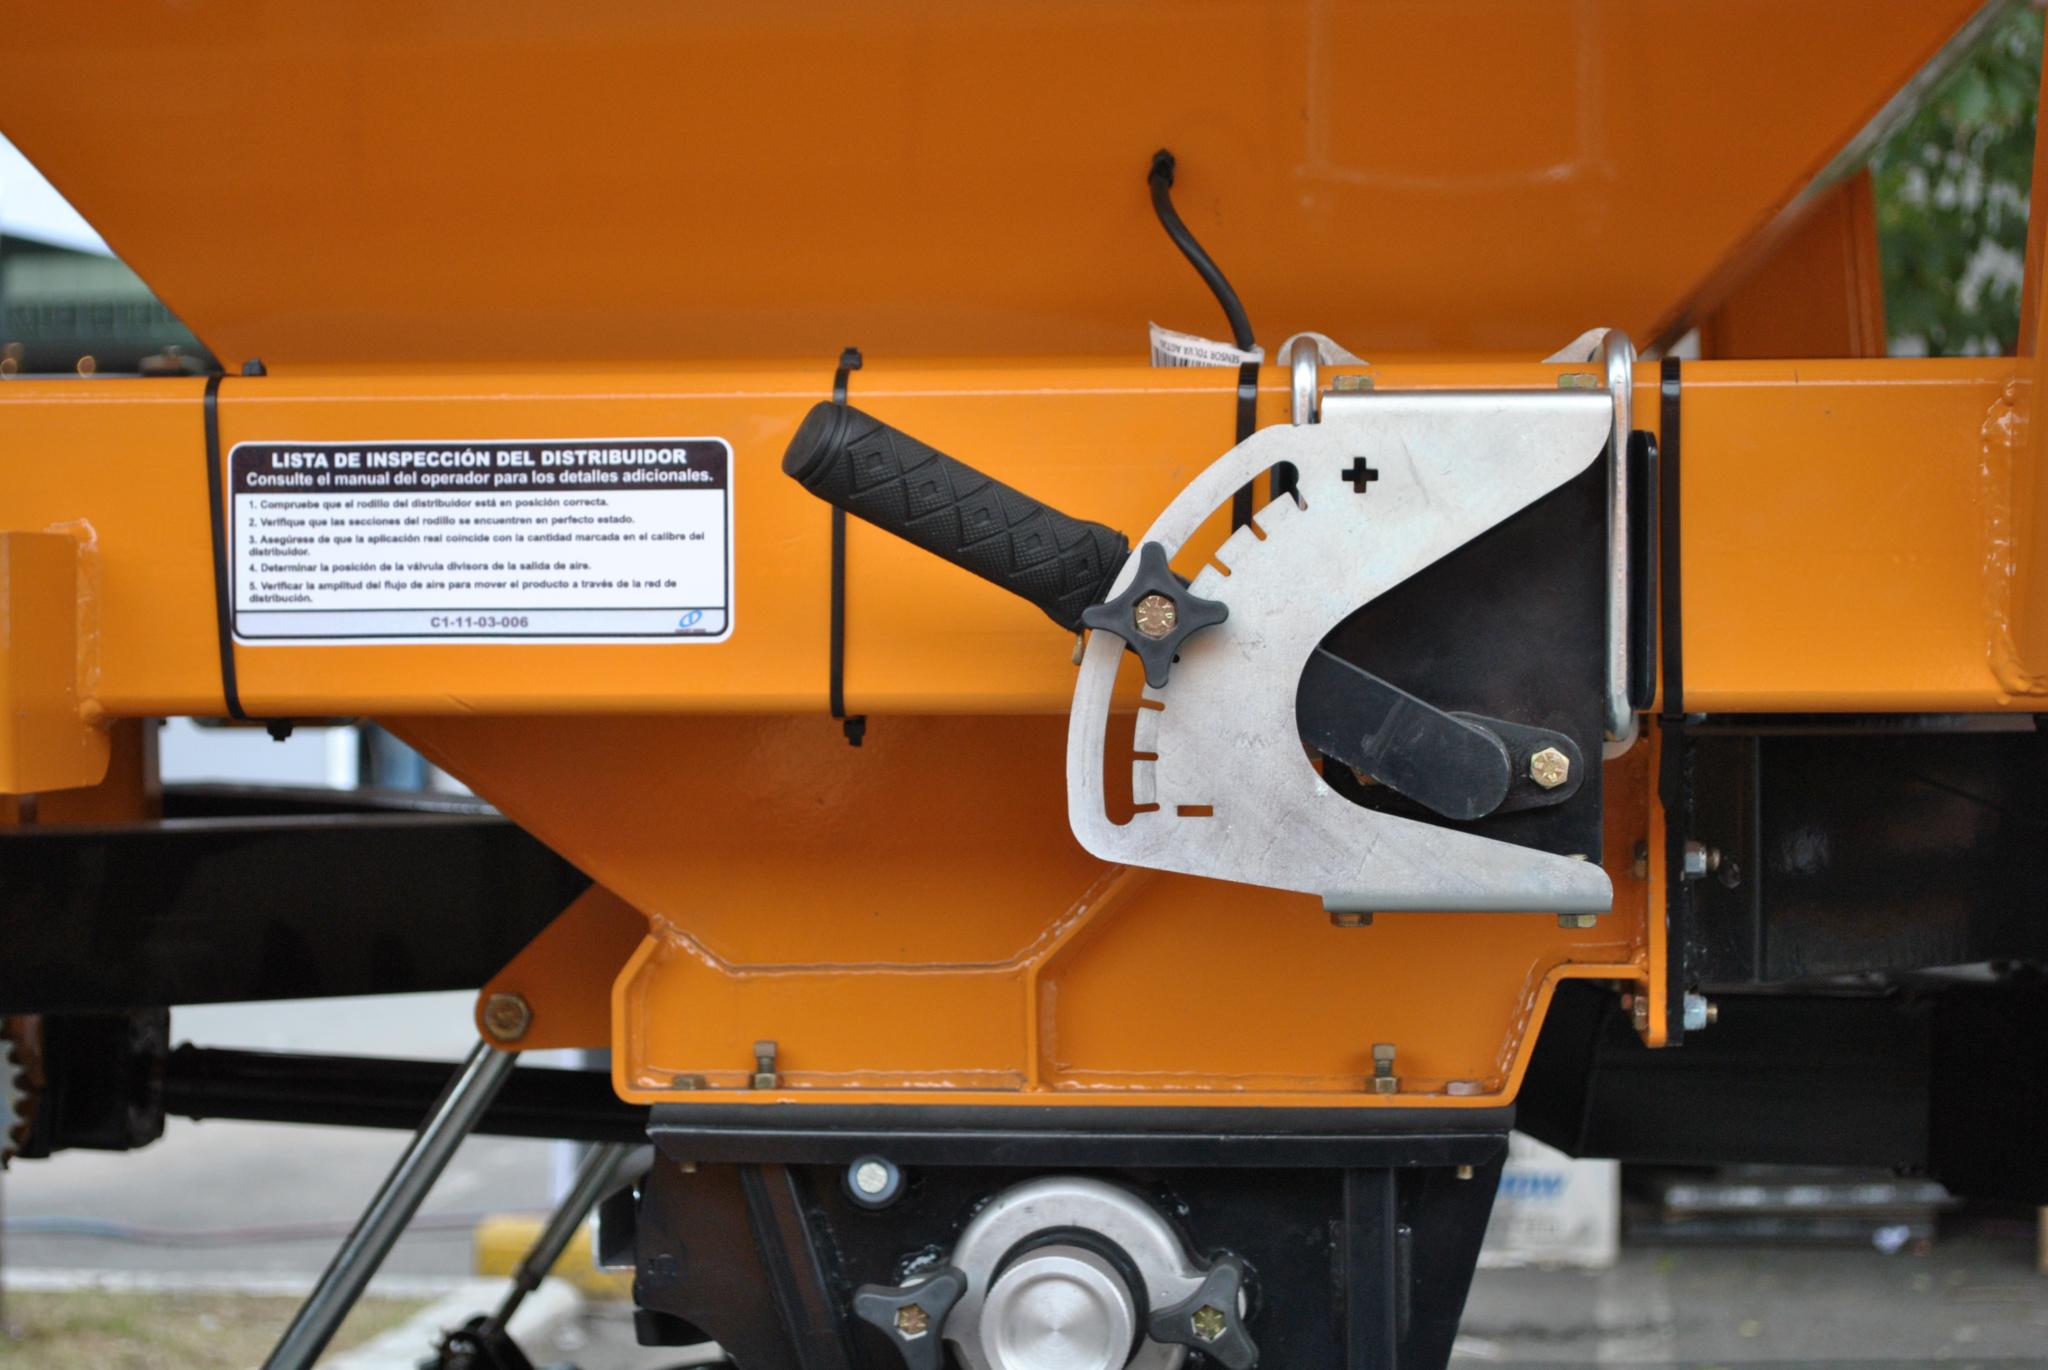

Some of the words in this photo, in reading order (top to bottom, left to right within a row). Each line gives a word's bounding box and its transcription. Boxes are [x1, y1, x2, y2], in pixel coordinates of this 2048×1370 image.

[1210, 350, 1241, 364] SENSOR
[271, 453, 329, 468] LISTA
[333, 453, 362, 467] DE
[366, 449, 491, 467] INSPECCIÓN
[496, 451, 536, 466] DEL
[540, 449, 688, 465] DISTRIBUIDOR
[246, 472, 314, 486] Consulte
[316, 473, 331, 485] el
[334, 472, 391, 485] manual
[393, 472, 418, 484] del
[420, 471, 491, 487] operador
[493, 473, 529, 486] para
[531, 470, 556, 483] los
[558, 470, 619, 483] detalles
[621, 469, 715, 482] adicionales.
[248, 500, 259, 508] 1.
[260, 501, 320, 511] Compruebe
[322, 502, 342, 511] que
[344, 500, 354, 509] el
[356, 500, 390, 508] rodillo
[392, 500, 409, 508] del
[411, 499, 472, 508] distribuidor
[474, 500, 497, 508] está
[515, 499, 560, 509] posición
[562, 498, 610, 506] correcta.
[248, 519, 259, 527] 2.
[260, 518, 306, 528] Verifique
[308, 520, 328, 529] que
[330, 518, 346, 526] las
[348, 518, 401, 526] secciones
[403, 518, 420, 526] del
[422, 517, 456, 525] rodillo
[473, 517, 533, 525] encuentren
[551, 516, 595, 526] perfecto
[597, 516, 634, 524] estado.
[248, 536, 259, 544] 3.
[259, 536, 315, 546] Asegúrese
[317, 536, 331, 544] de
[333, 537, 353, 545] que
[355, 536, 365, 544] la
[367, 535, 421, 545] aplicación
[423, 535, 443, 543] real
[445, 535, 490, 543] coincide
[515, 534, 525, 542] la
[527, 534, 573, 542] cantidad
[575, 534, 620, 542] marcada
[638, 533, 648, 541] el
[650, 533, 686, 541] calibre
[688, 533, 705, 541] del
[247, 548, 312, 557] distribuidor.
[248, 564, 259, 572] 4.
[260, 564, 317, 573] Determinar
[320, 564, 330, 572] la
[332, 564, 377, 574] posición
[379, 563, 392, 571] de
[395, 563, 405, 571] la
[407, 563, 444, 571] válvula
[446, 563, 489, 571] divisora
[491, 562, 505, 570] de
[507, 563, 517, 571] la
[519, 562, 551, 570] salida
[553, 562, 566, 570] de
[248, 582, 259, 591] 5.
[260, 582, 304, 591] Verificar
[305, 582, 316, 590] la
[317, 582, 364, 591] amplitud
[365, 582, 382, 590] del
[383, 581, 408, 591] flujo
[409, 581, 424, 589] de
[447, 582, 472, 590] para
[473, 581, 508, 589] mover
[509, 581, 520, 589] el
[521, 581, 570, 590] producto
[580, 580, 614, 588] través
[615, 580, 630, 588] de
[643, 580, 662, 588] red
[663, 580, 678, 588] de
[247, 595, 315, 603] distribución.
[430, 616, 529, 628] C1-11-03-006
